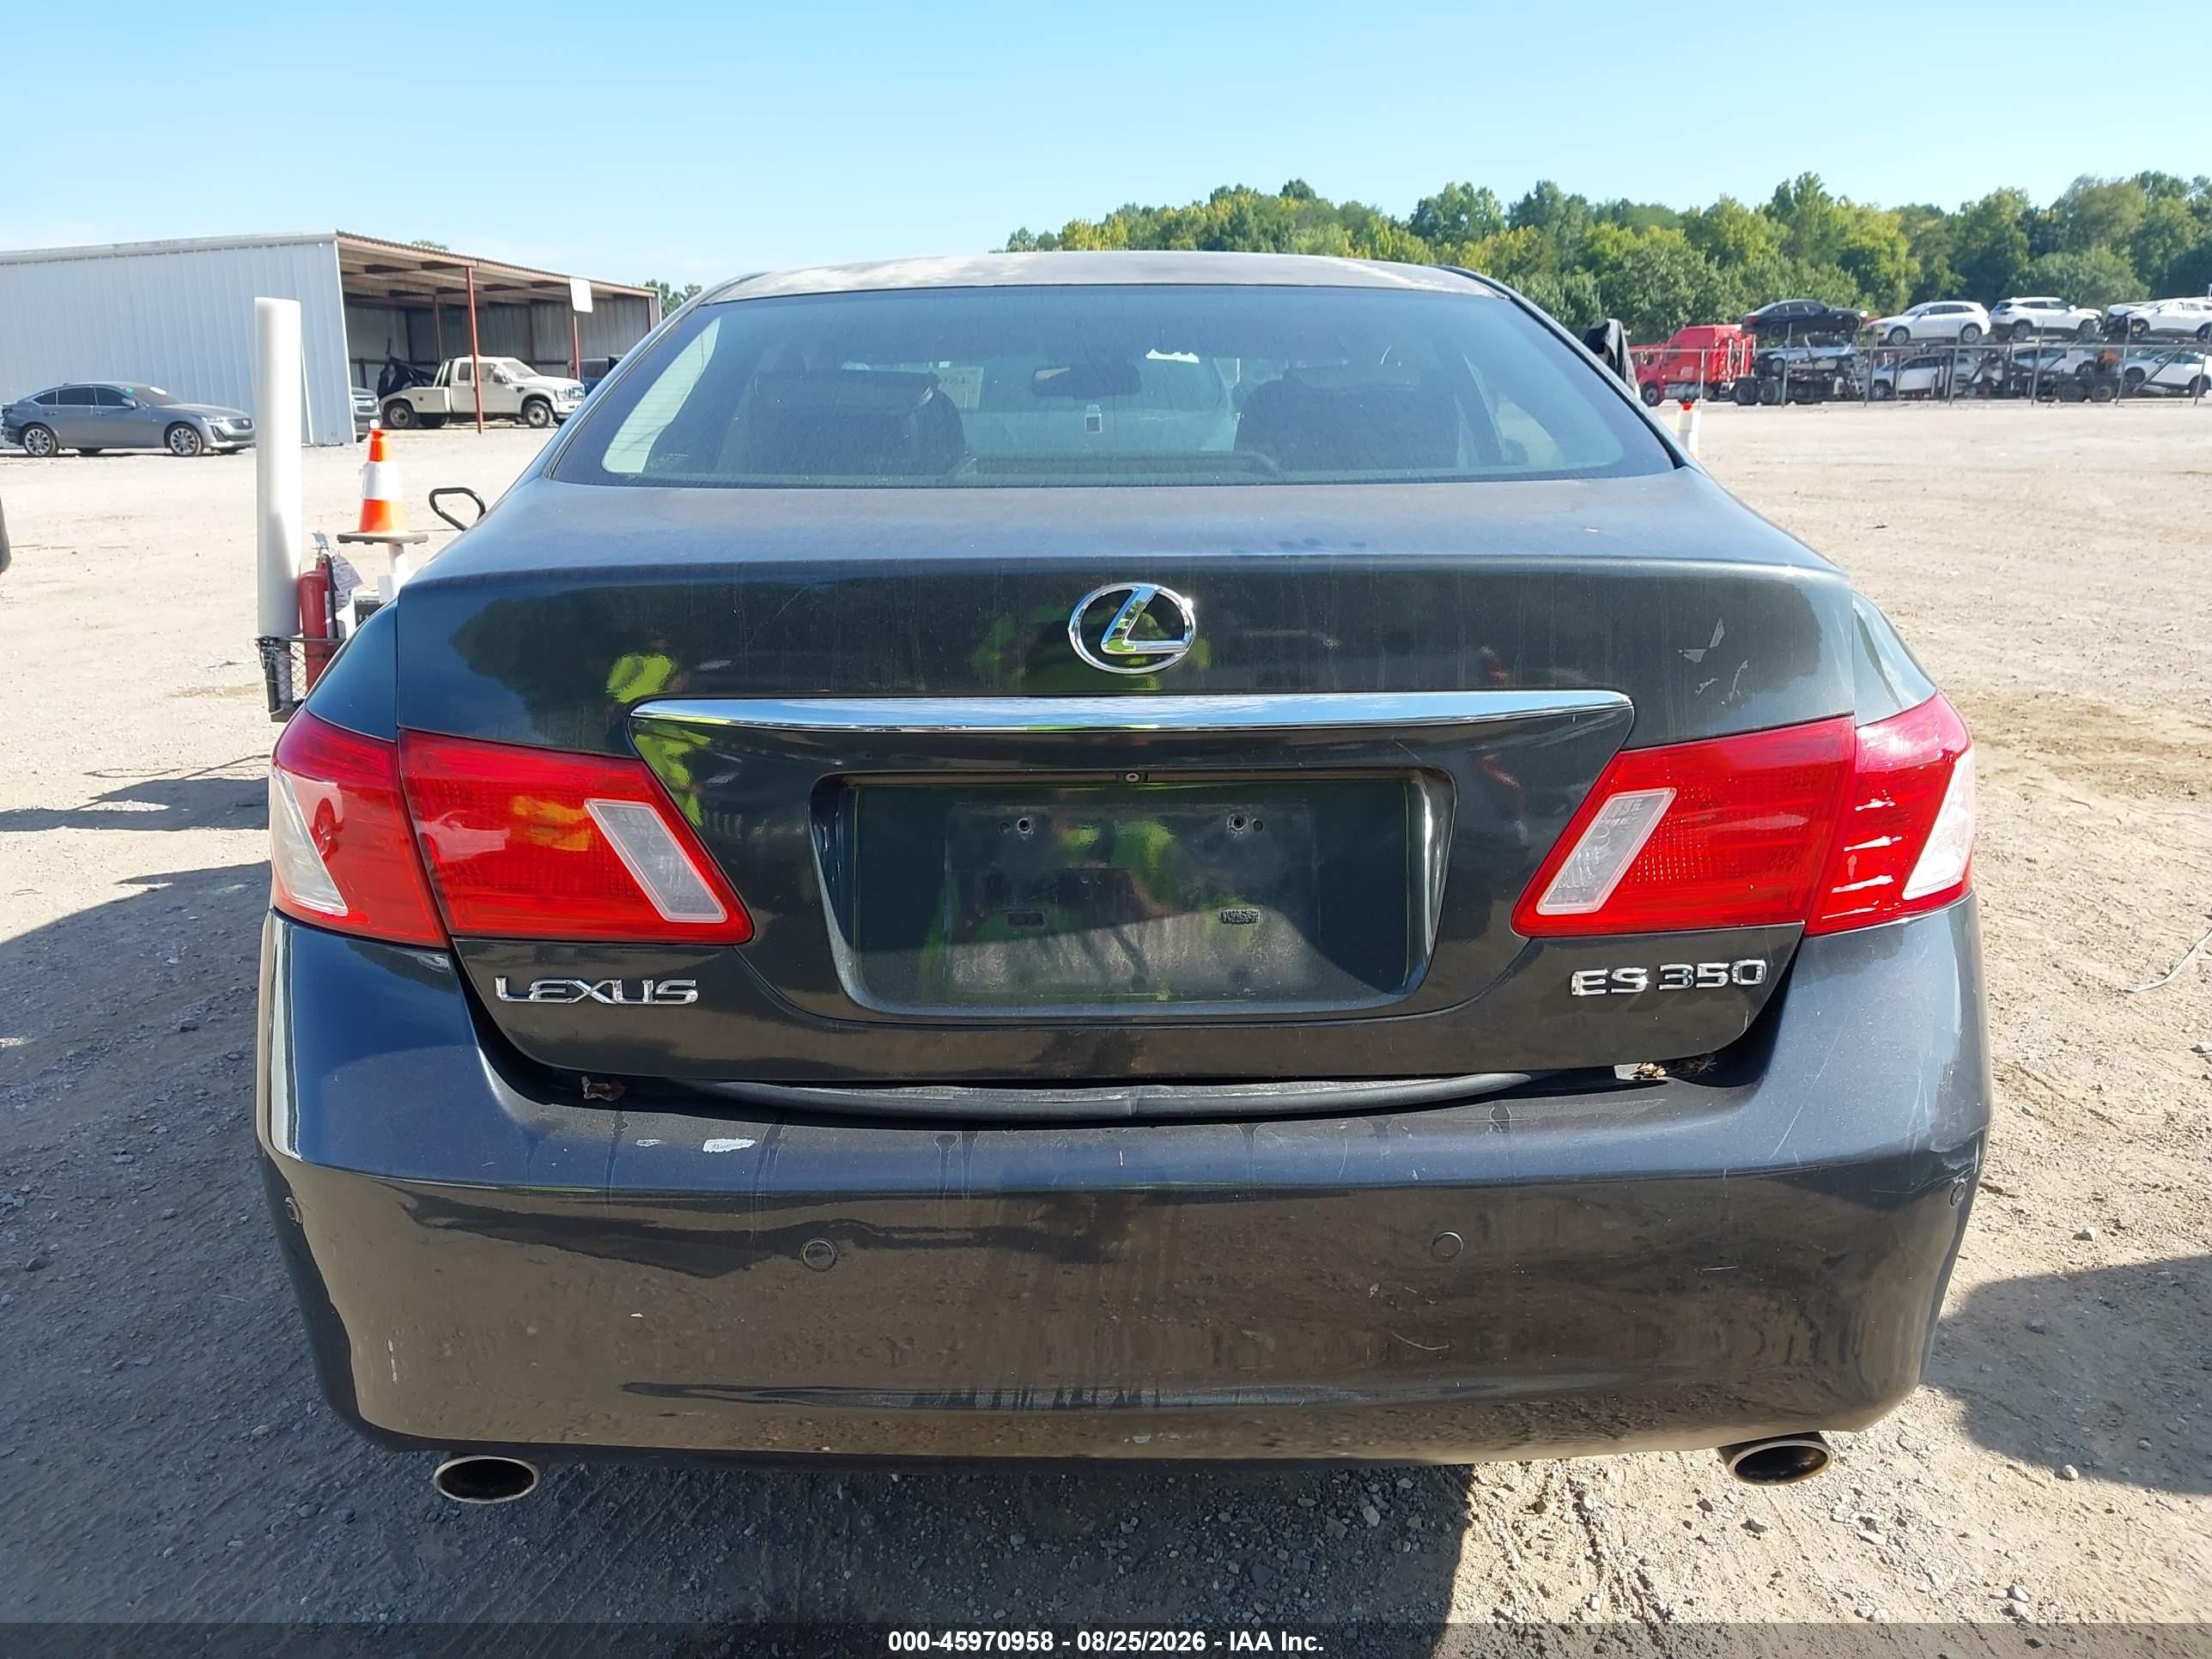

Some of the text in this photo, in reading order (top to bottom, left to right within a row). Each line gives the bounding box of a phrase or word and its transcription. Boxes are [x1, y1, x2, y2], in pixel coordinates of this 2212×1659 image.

[495, 976, 698, 1004] LEXUS
[1571, 958, 1767, 996] ES 350
